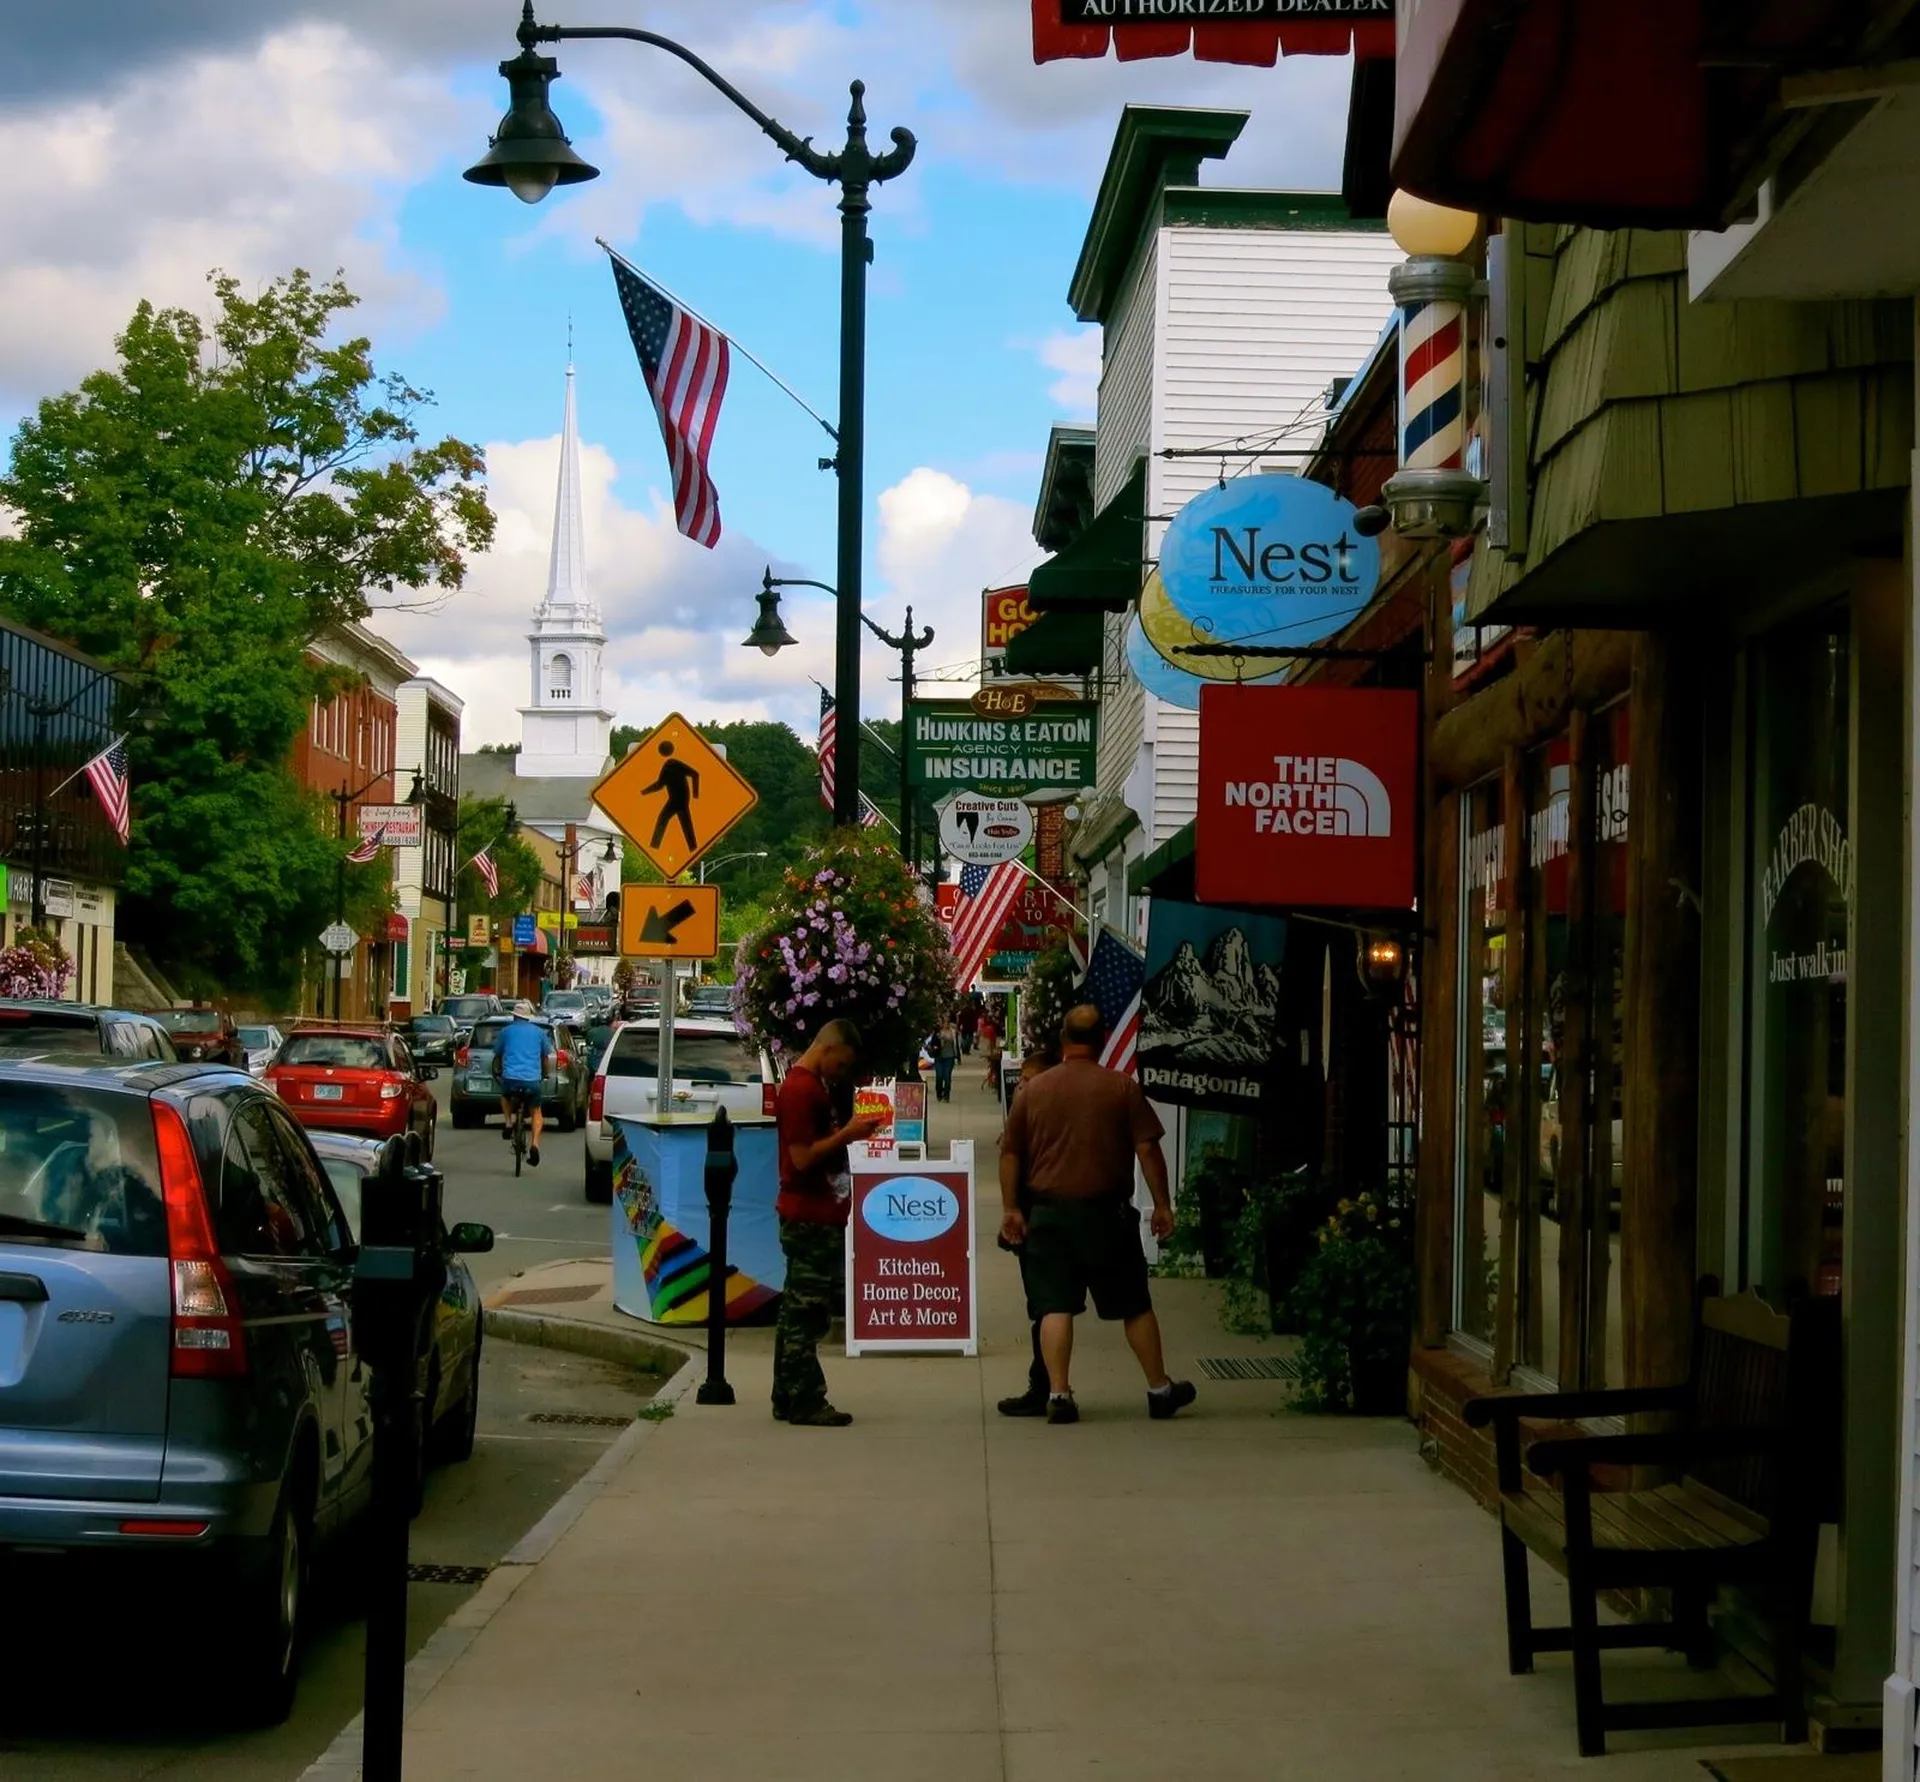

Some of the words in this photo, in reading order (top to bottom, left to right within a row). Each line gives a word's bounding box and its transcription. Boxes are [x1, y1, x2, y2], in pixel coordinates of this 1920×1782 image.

[1081, 0, 1262, 15] AUTHORIZED
[1276, 0, 1390, 12] DEALER
[1209, 527, 1360, 583] Nest
[1210, 586, 1271, 595] TREASURES
[1274, 586, 1296, 595] FOR
[1299, 586, 1328, 595] YOUR
[1331, 585, 1360, 595] NEST
[916, 716, 1006, 741] HUNKINS
[1010, 724, 1022, 742] &
[1025, 718, 1091, 743] EATON
[925, 757, 1081, 780] INSURANCE
[1274, 756, 1335, 783] THE
[955, 801, 996, 812] Creative
[997, 802, 1019, 812] Cuts
[1225, 782, 1333, 809] NORTH
[1255, 808, 1334, 835] FACE
[1762, 803, 1818, 931] BARBER
[1024, 909, 1043, 920] TO
[1769, 951, 1796, 982] Just
[1143, 1067, 1260, 1098] patagonia
[886, 1194, 948, 1217] Nest
[878, 1258, 945, 1278] Kitchen,
[863, 1283, 909, 1301] Home
[912, 1283, 961, 1303] Decor,
[868, 1308, 895, 1326] Art
[899, 1307, 913, 1326] &
[916, 1308, 958, 1326] More
